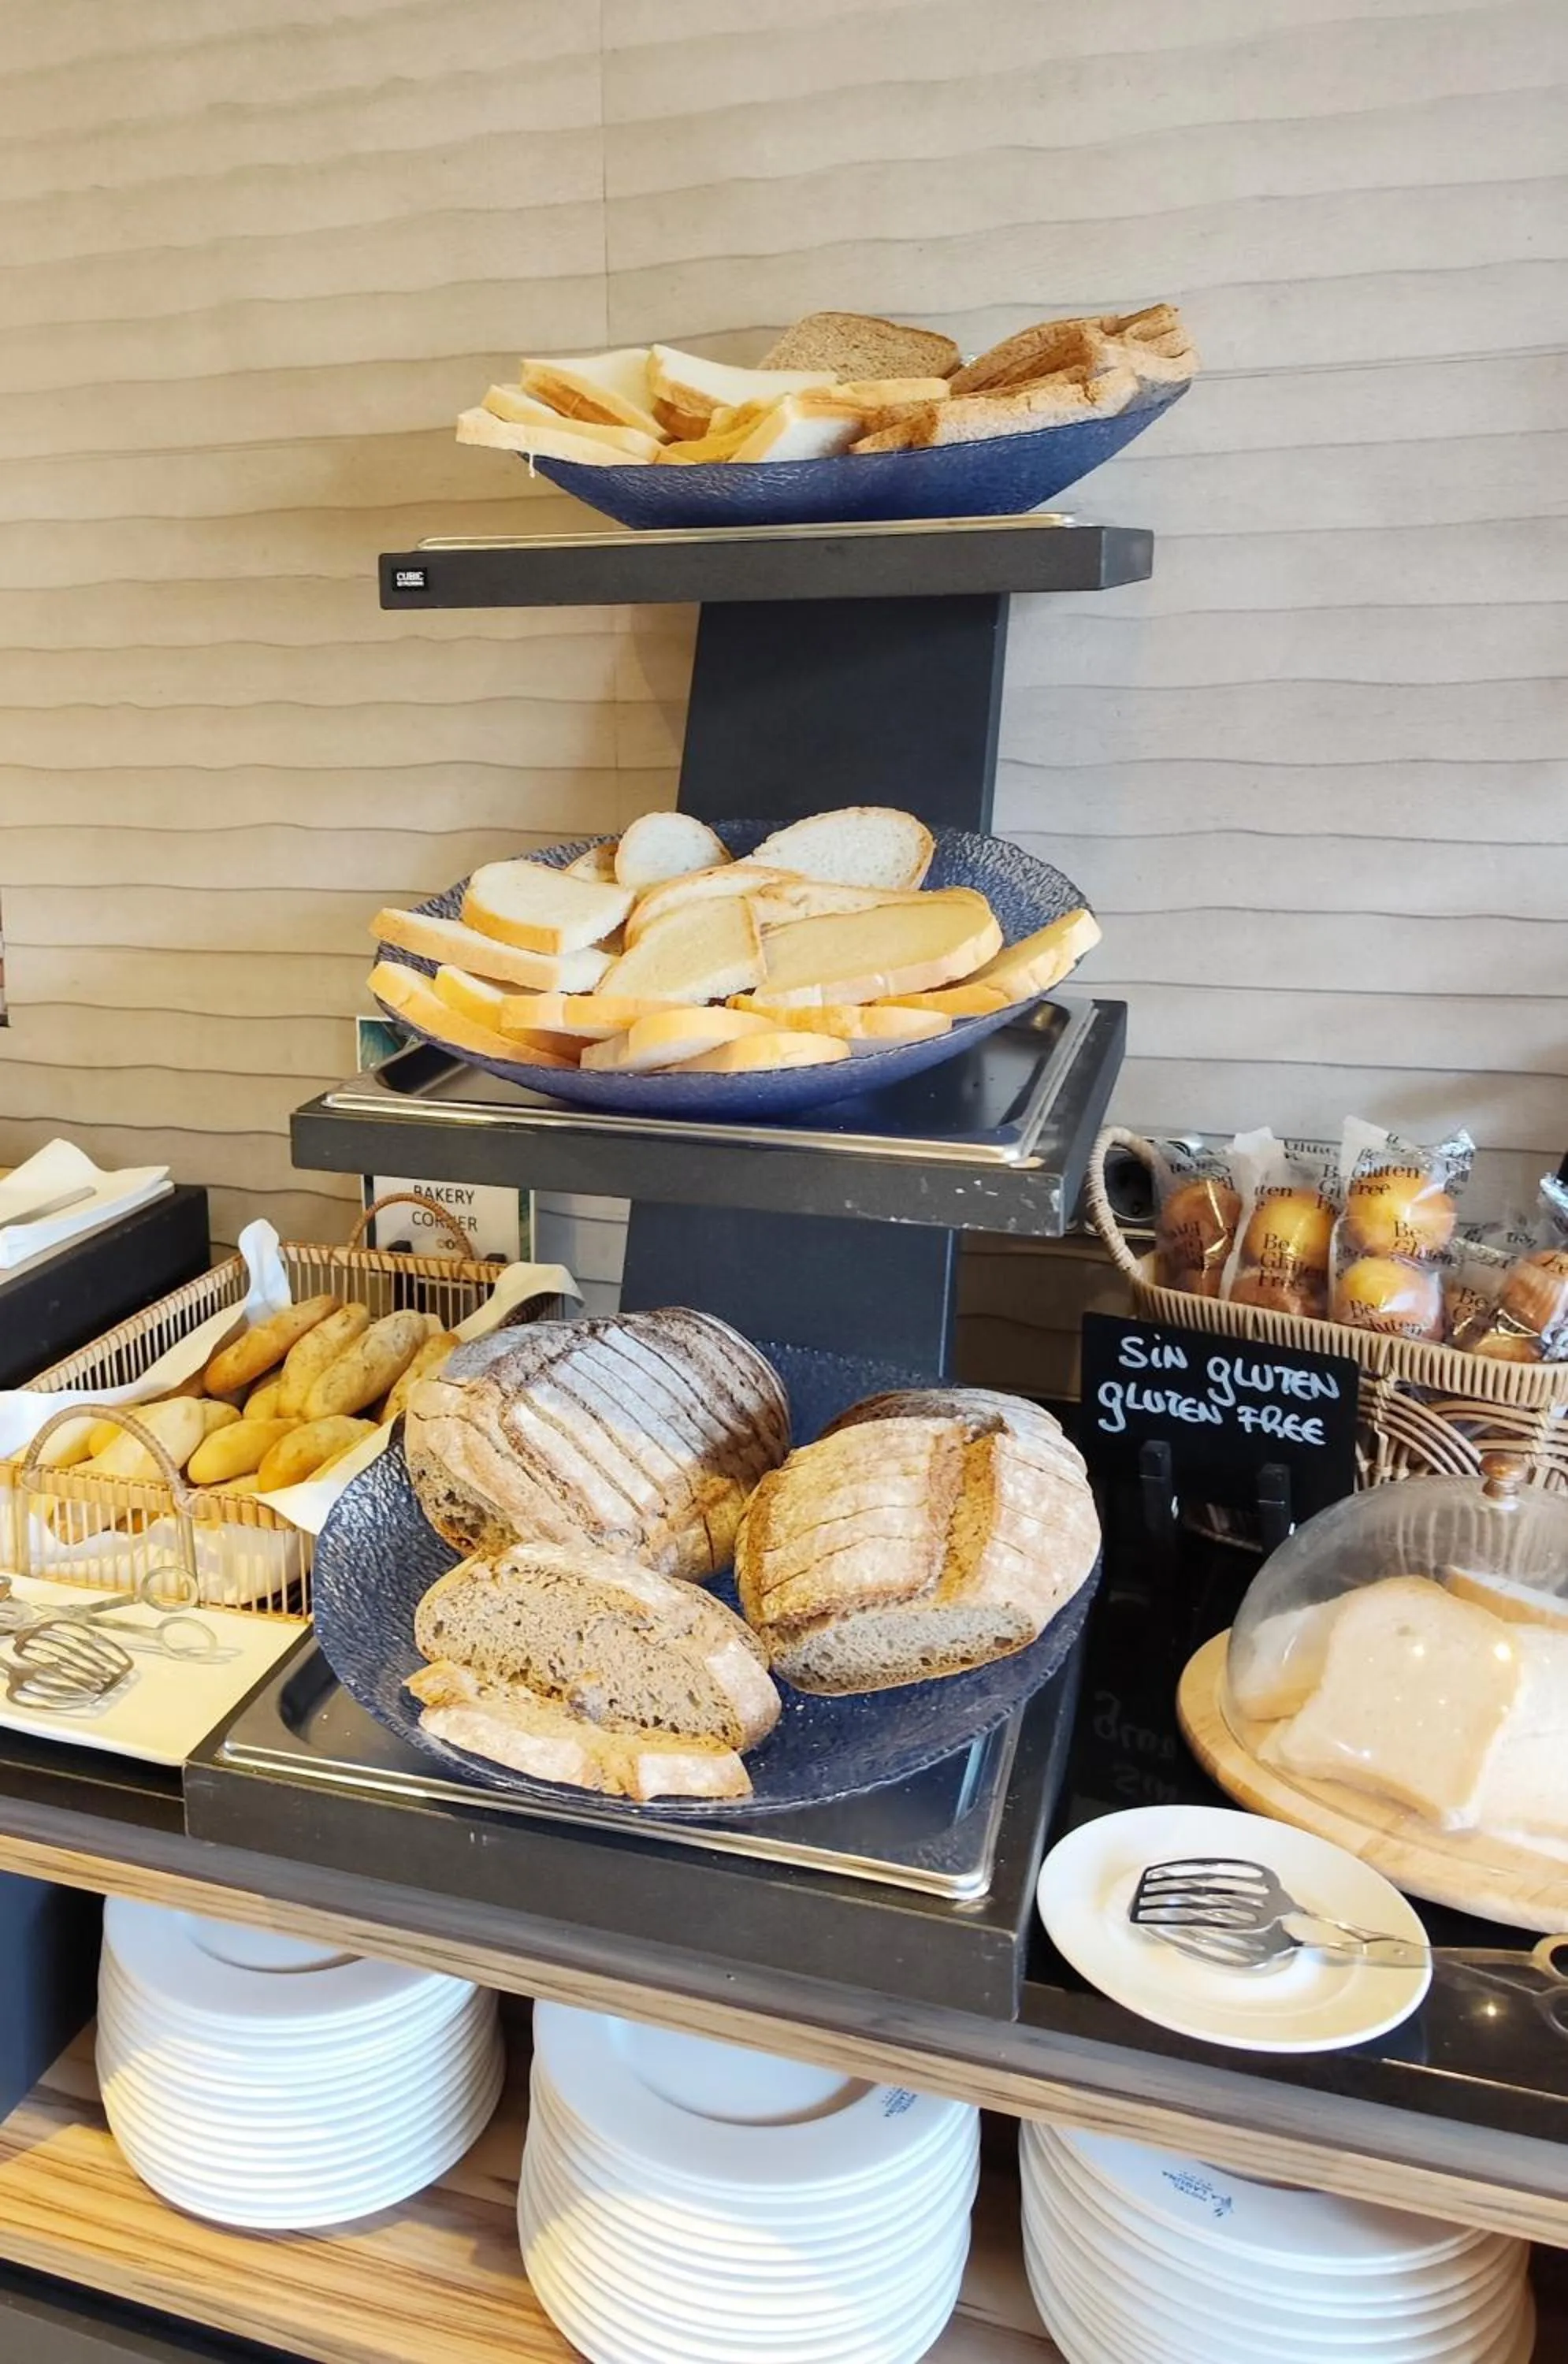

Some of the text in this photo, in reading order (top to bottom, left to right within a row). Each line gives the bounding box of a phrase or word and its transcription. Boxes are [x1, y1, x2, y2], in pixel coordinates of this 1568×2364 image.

[414, 1185, 475, 1204] BAKERY
[412, 1211, 478, 1232] CORER
[1236, 1405, 1326, 1445] FREE
